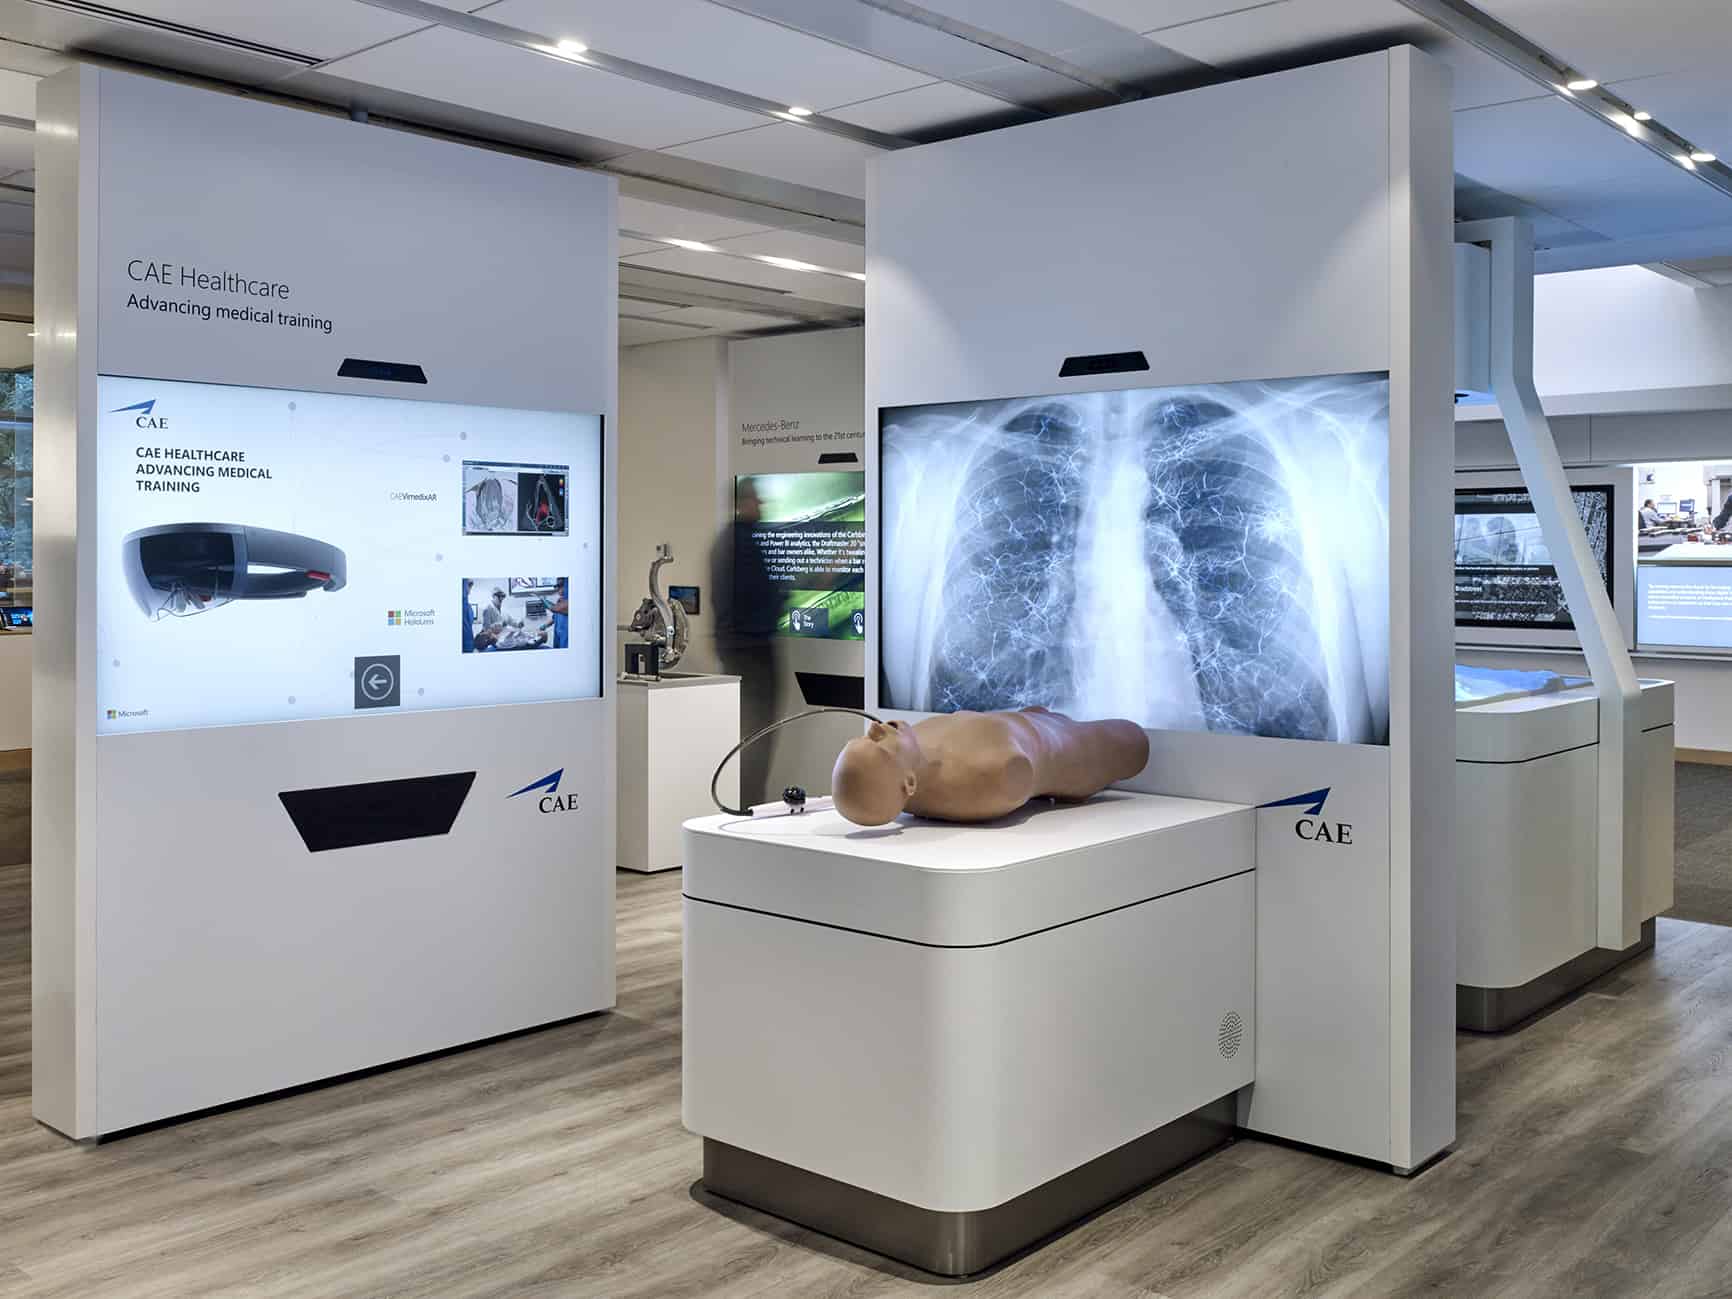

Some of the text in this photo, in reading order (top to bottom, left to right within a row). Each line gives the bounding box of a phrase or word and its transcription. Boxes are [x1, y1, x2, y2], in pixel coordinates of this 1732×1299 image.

[127, 259, 291, 300] CAE Healthcare
[126, 293, 333, 334] Advancing medical training
[135, 416, 169, 430] CAE
[741, 420, 800, 433] Mercedes-Benz
[846, 431, 865, 440] centur
[135, 446, 246, 463] CAE HEALTHCARE
[135, 463, 273, 480] ADVANCING MEDICAL
[135, 479, 201, 493] TRAINING
[539, 794, 579, 813] CAE
[1295, 819, 1353, 845] CAE
